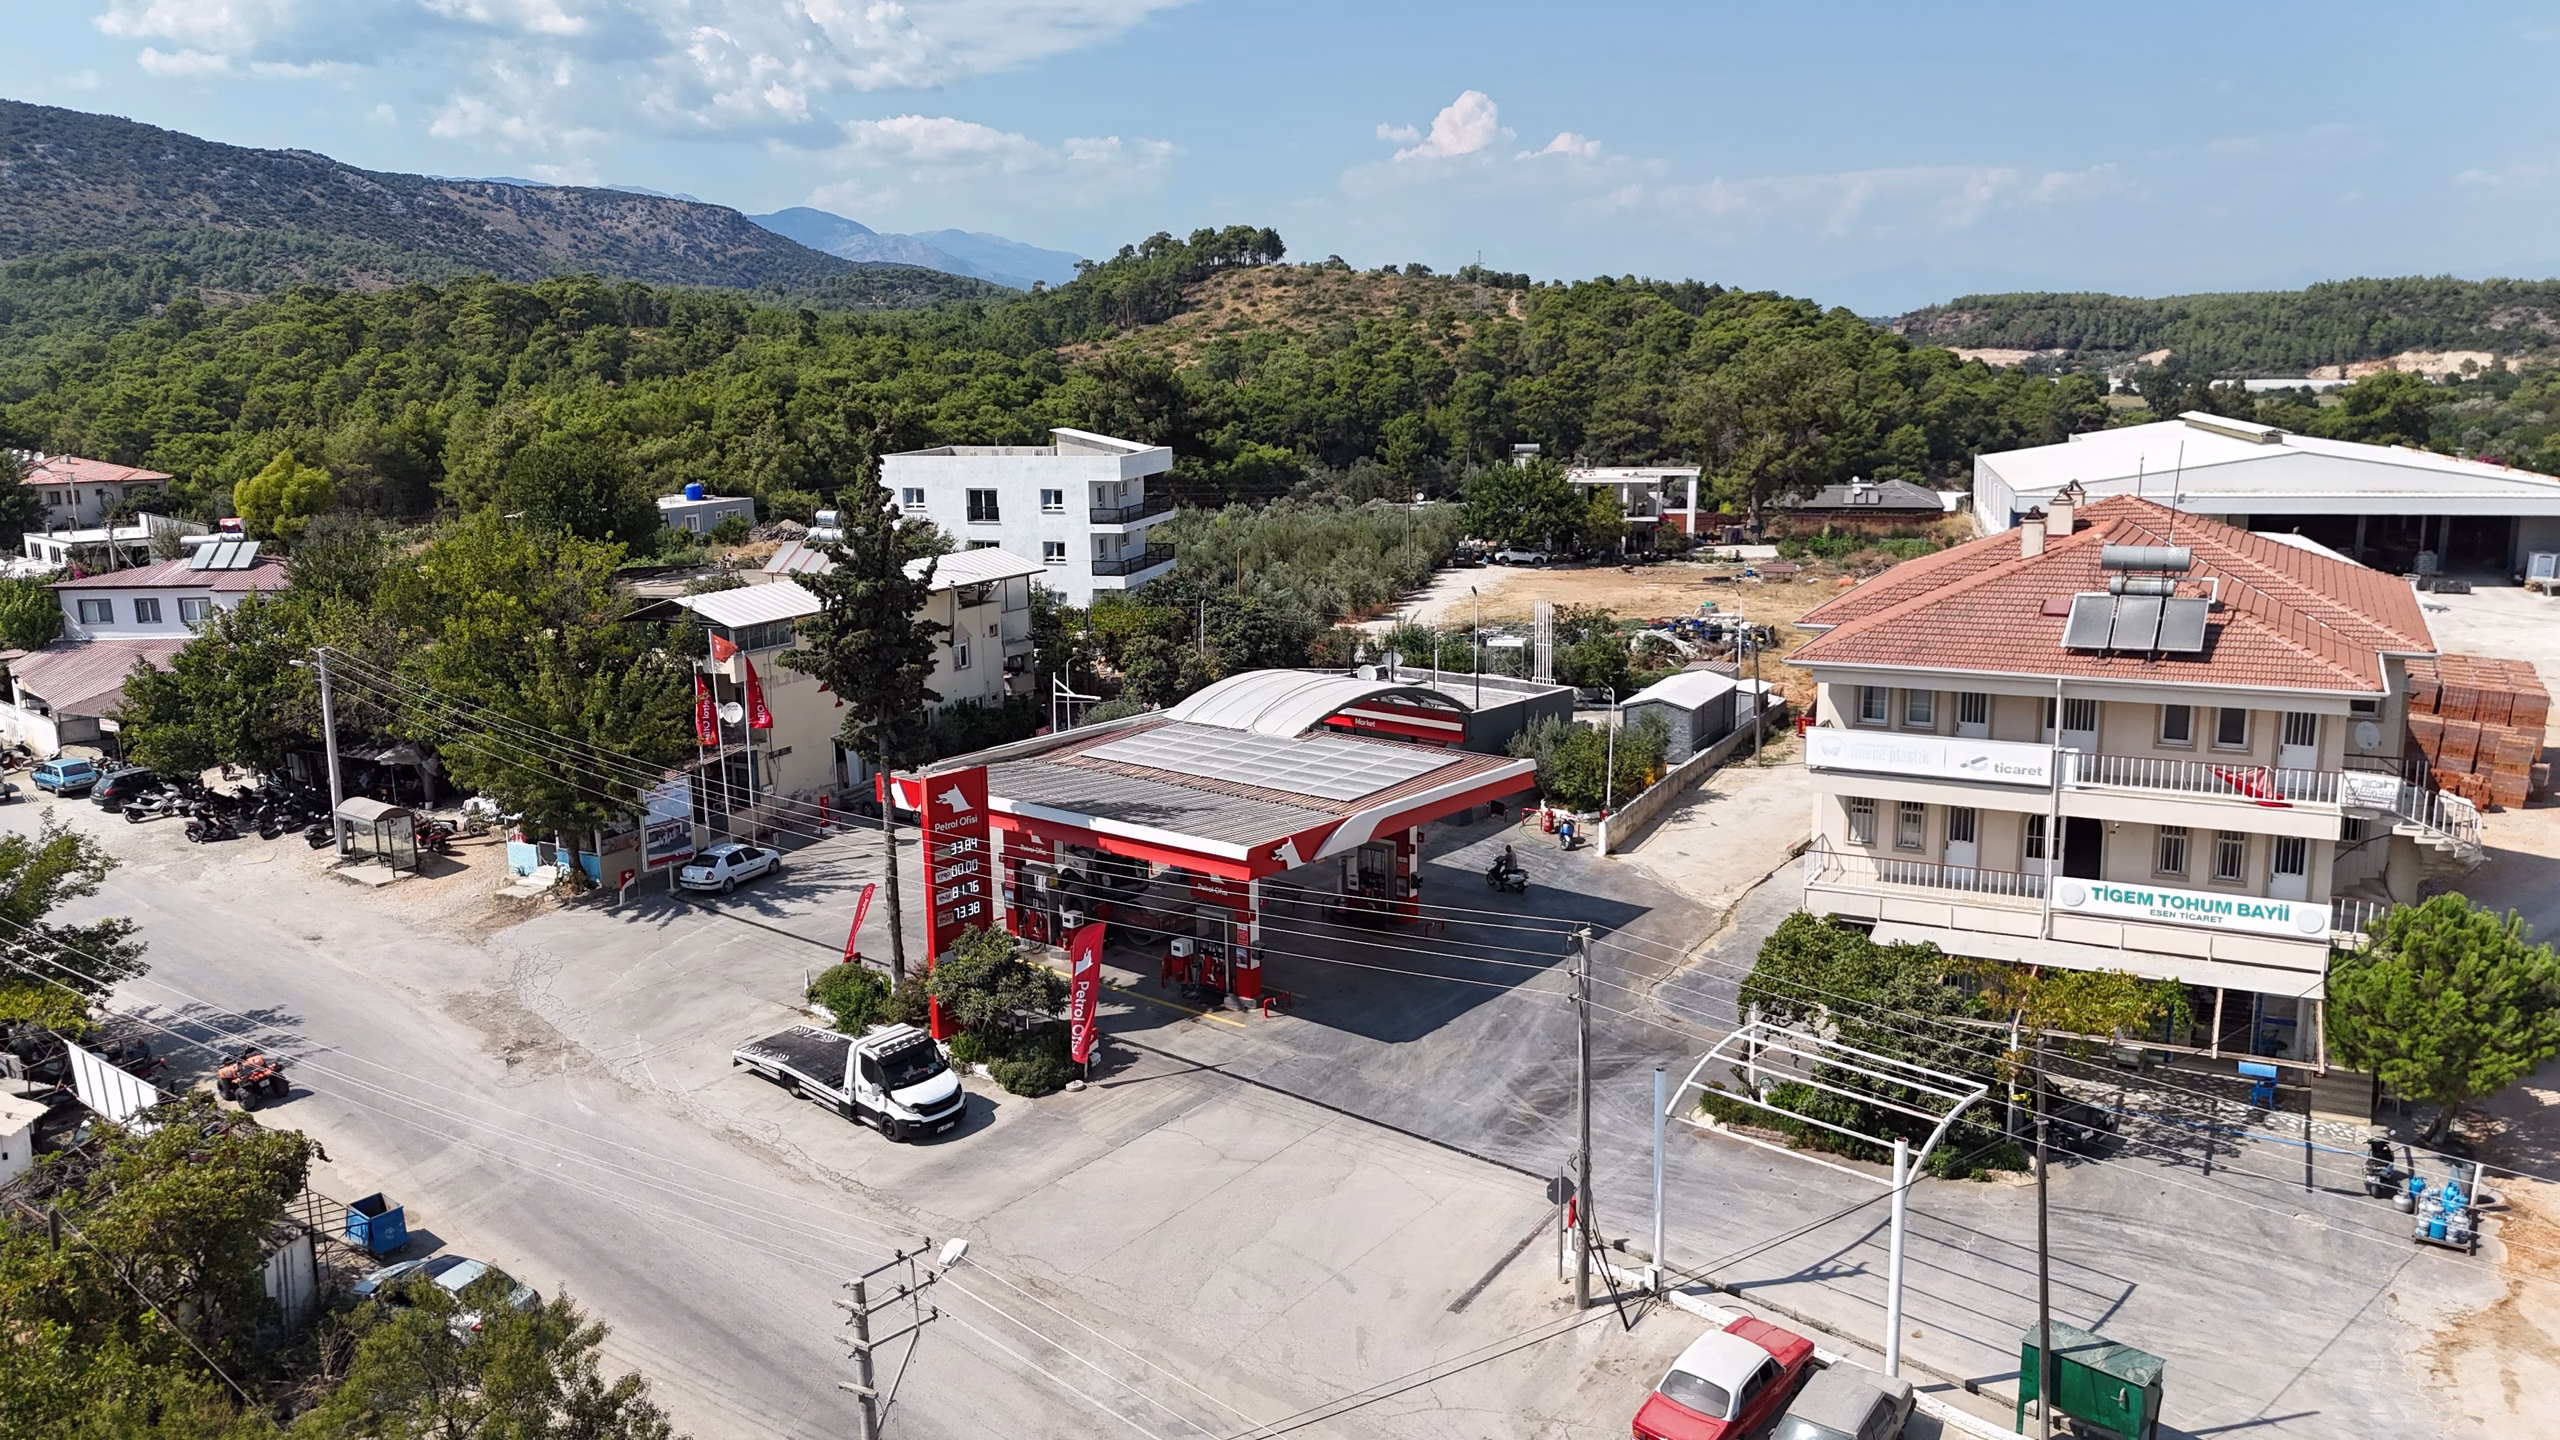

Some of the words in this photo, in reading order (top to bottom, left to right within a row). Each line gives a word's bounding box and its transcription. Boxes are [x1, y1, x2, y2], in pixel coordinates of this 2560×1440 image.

[1354, 717, 1376, 728] Market
[1993, 762, 2043, 777] ticaret
[934, 820, 958, 833] Petrol
[959, 814, 978, 826] Ofisi
[2091, 885, 2154, 906] TİGEM
[2157, 893, 2233, 915] TOHUM
[953, 901, 980, 920] 73.38
[2149, 908, 2176, 919] ESEN
[2179, 911, 2223, 924] TİCARET
[1073, 981, 1090, 1021] Petrol
